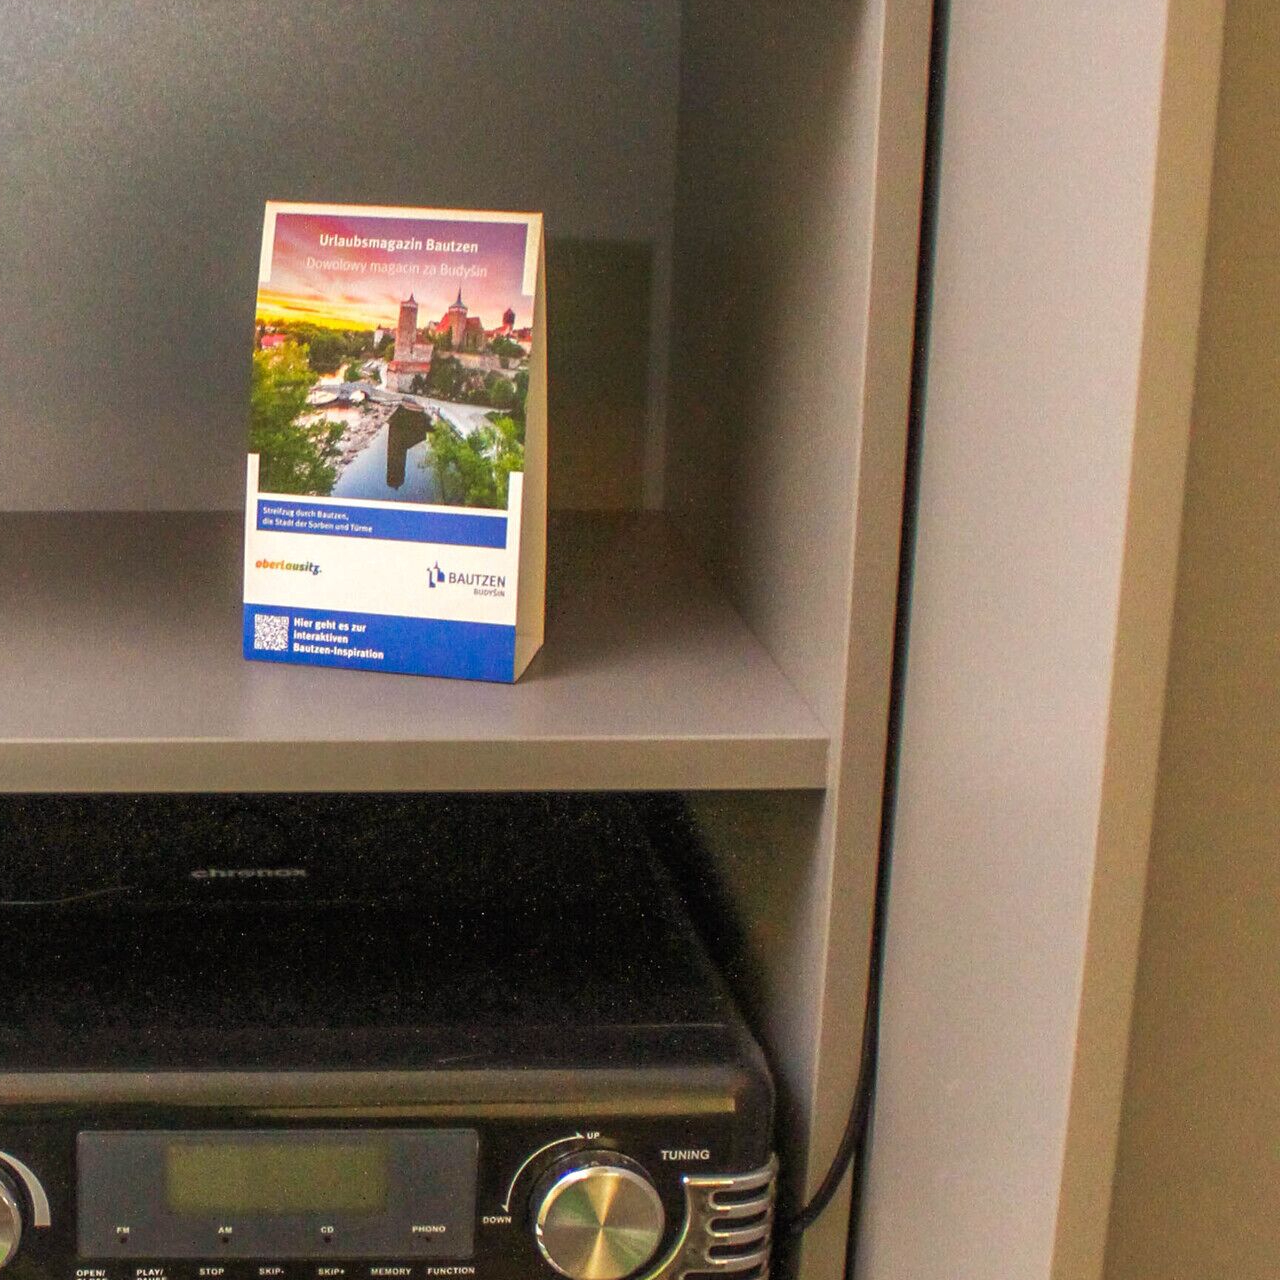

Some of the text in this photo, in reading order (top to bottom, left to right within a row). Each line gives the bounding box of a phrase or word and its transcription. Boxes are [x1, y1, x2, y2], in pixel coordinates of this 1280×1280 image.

[319, 234, 478, 253] Urlaubsmagazin Bautzen
[263, 506, 349, 522] Streifzug durch Bautzen,
[262, 517, 373, 533] die Stadt der Sorben und Türme
[449, 572, 506, 587] BAUTZEN
[294, 617, 367, 632] Hier geht es zur
[293, 642, 385, 661] Bautzen-Inspiration
[586, 1132, 600, 1140] UP
[660, 1149, 710, 1161] TUNING
[482, 1215, 512, 1224] DOWN
[218, 1226, 233, 1234] AM
[320, 1226, 334, 1234] CD
[411, 1225, 446, 1234] PHONO
[76, 1269, 106, 1278] OPEN/
[136, 1268, 164, 1277] PLAY/
[199, 1267, 225, 1276] STOP
[370, 1267, 412, 1276] MEMORY
[427, 1266, 476, 1275] FUNCTION
